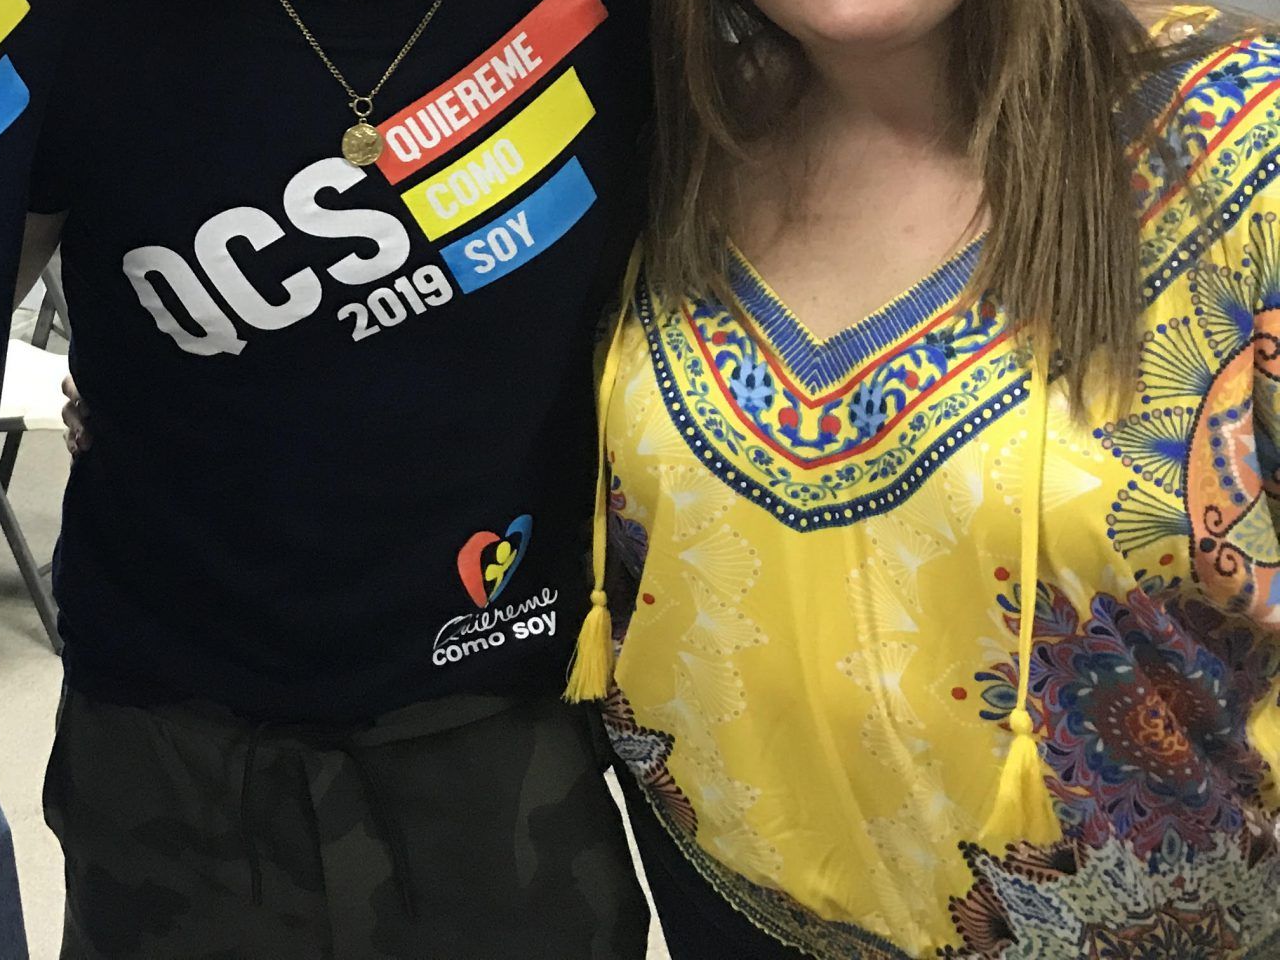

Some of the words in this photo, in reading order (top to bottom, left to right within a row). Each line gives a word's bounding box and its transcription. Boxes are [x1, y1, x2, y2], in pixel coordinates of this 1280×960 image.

[385, 32, 543, 163] QUIEREME
[425, 138, 524, 220] COMO
[122, 157, 411, 356] QCS
[464, 211, 535, 275] SOY
[337, 264, 454, 342] 2019
[432, 632, 506, 666] como
[512, 611, 556, 640] soy
